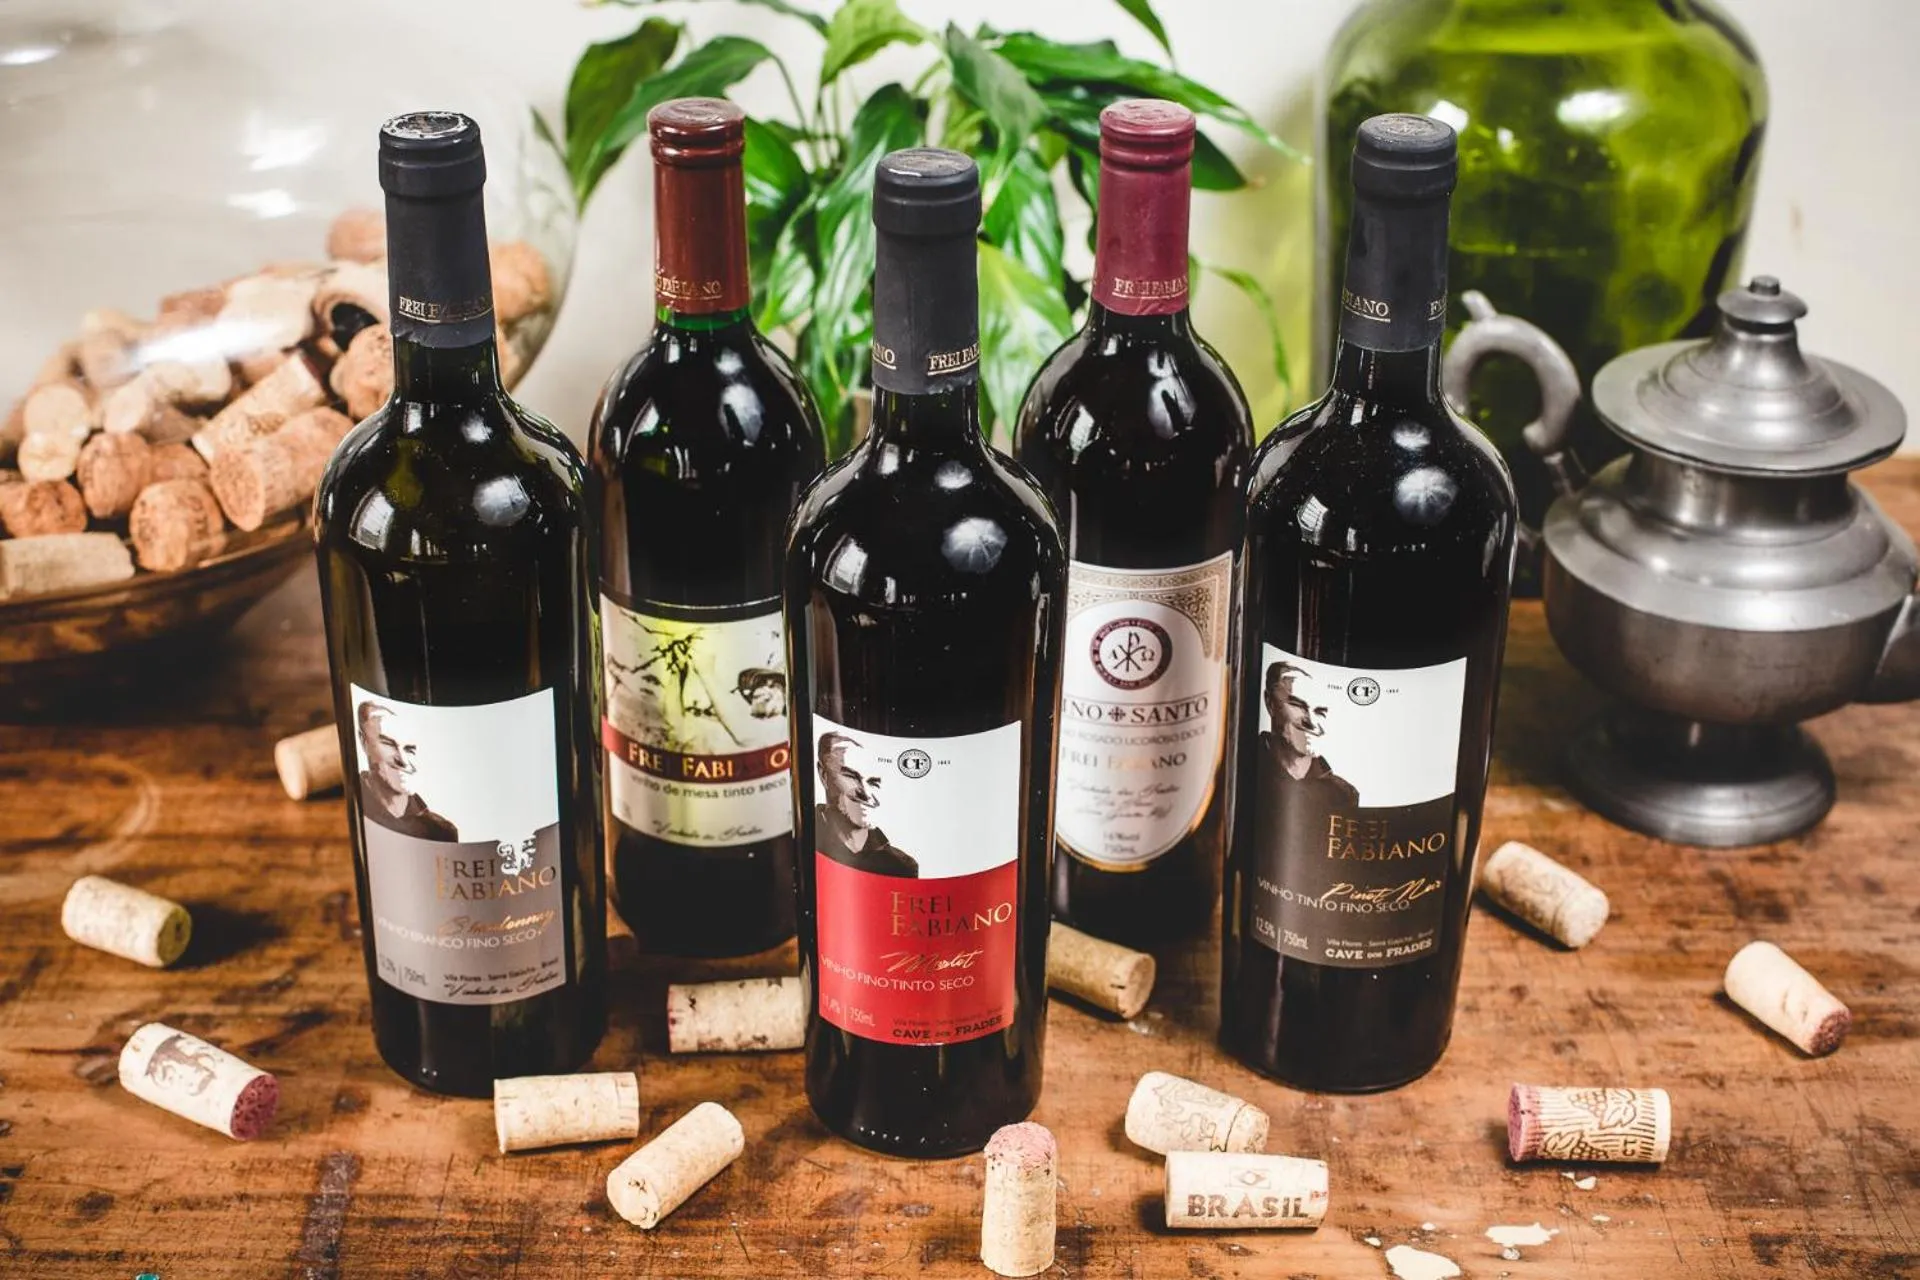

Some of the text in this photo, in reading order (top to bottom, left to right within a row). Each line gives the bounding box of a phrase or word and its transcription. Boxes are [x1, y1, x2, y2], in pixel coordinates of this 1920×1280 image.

[399, 296, 426, 317] FREI
[928, 350, 961, 370] FREI
[1130, 696, 1208, 724] SANTO
[663, 782, 680, 796] de
[683, 788, 719, 799] mesa
[723, 785, 756, 799] tinto
[758, 777, 787, 793] seco
[1327, 832, 1446, 861] FABIANO
[1257, 876, 1411, 914] VINHO TINTO FINO SECO
[466, 935, 500, 949] FINO
[1325, 947, 1364, 960] CAVE
[1386, 938, 1433, 958] FRADES
[857, 972, 889, 989] FINO
[890, 978, 936, 992] TINTO
[939, 975, 975, 991] SECO
[892, 1028, 931, 1040] CAVE
[1187, 1194, 1309, 1219] BRASIL
